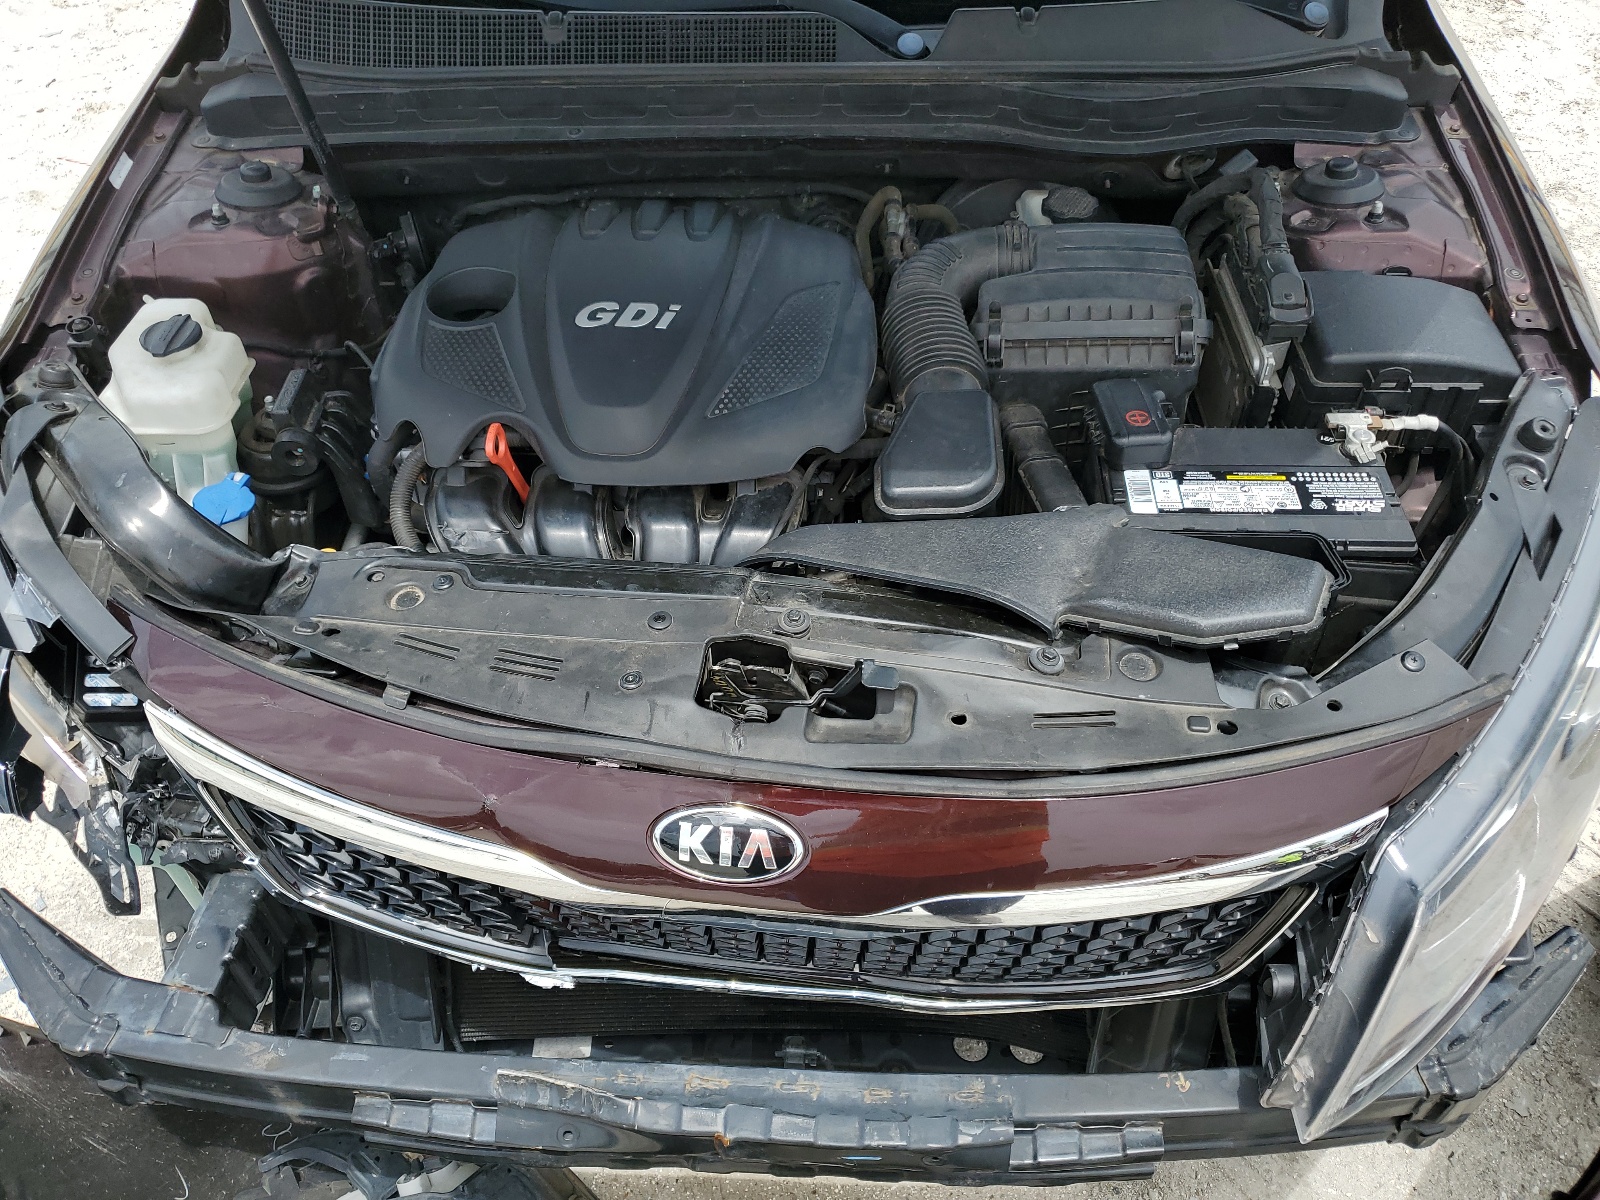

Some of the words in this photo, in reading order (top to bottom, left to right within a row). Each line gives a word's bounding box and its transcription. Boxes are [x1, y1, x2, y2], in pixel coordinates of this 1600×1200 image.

[575, 301, 682, 329] GDi
[1336, 499, 1386, 507] START
[678, 821, 777, 869] KIA
